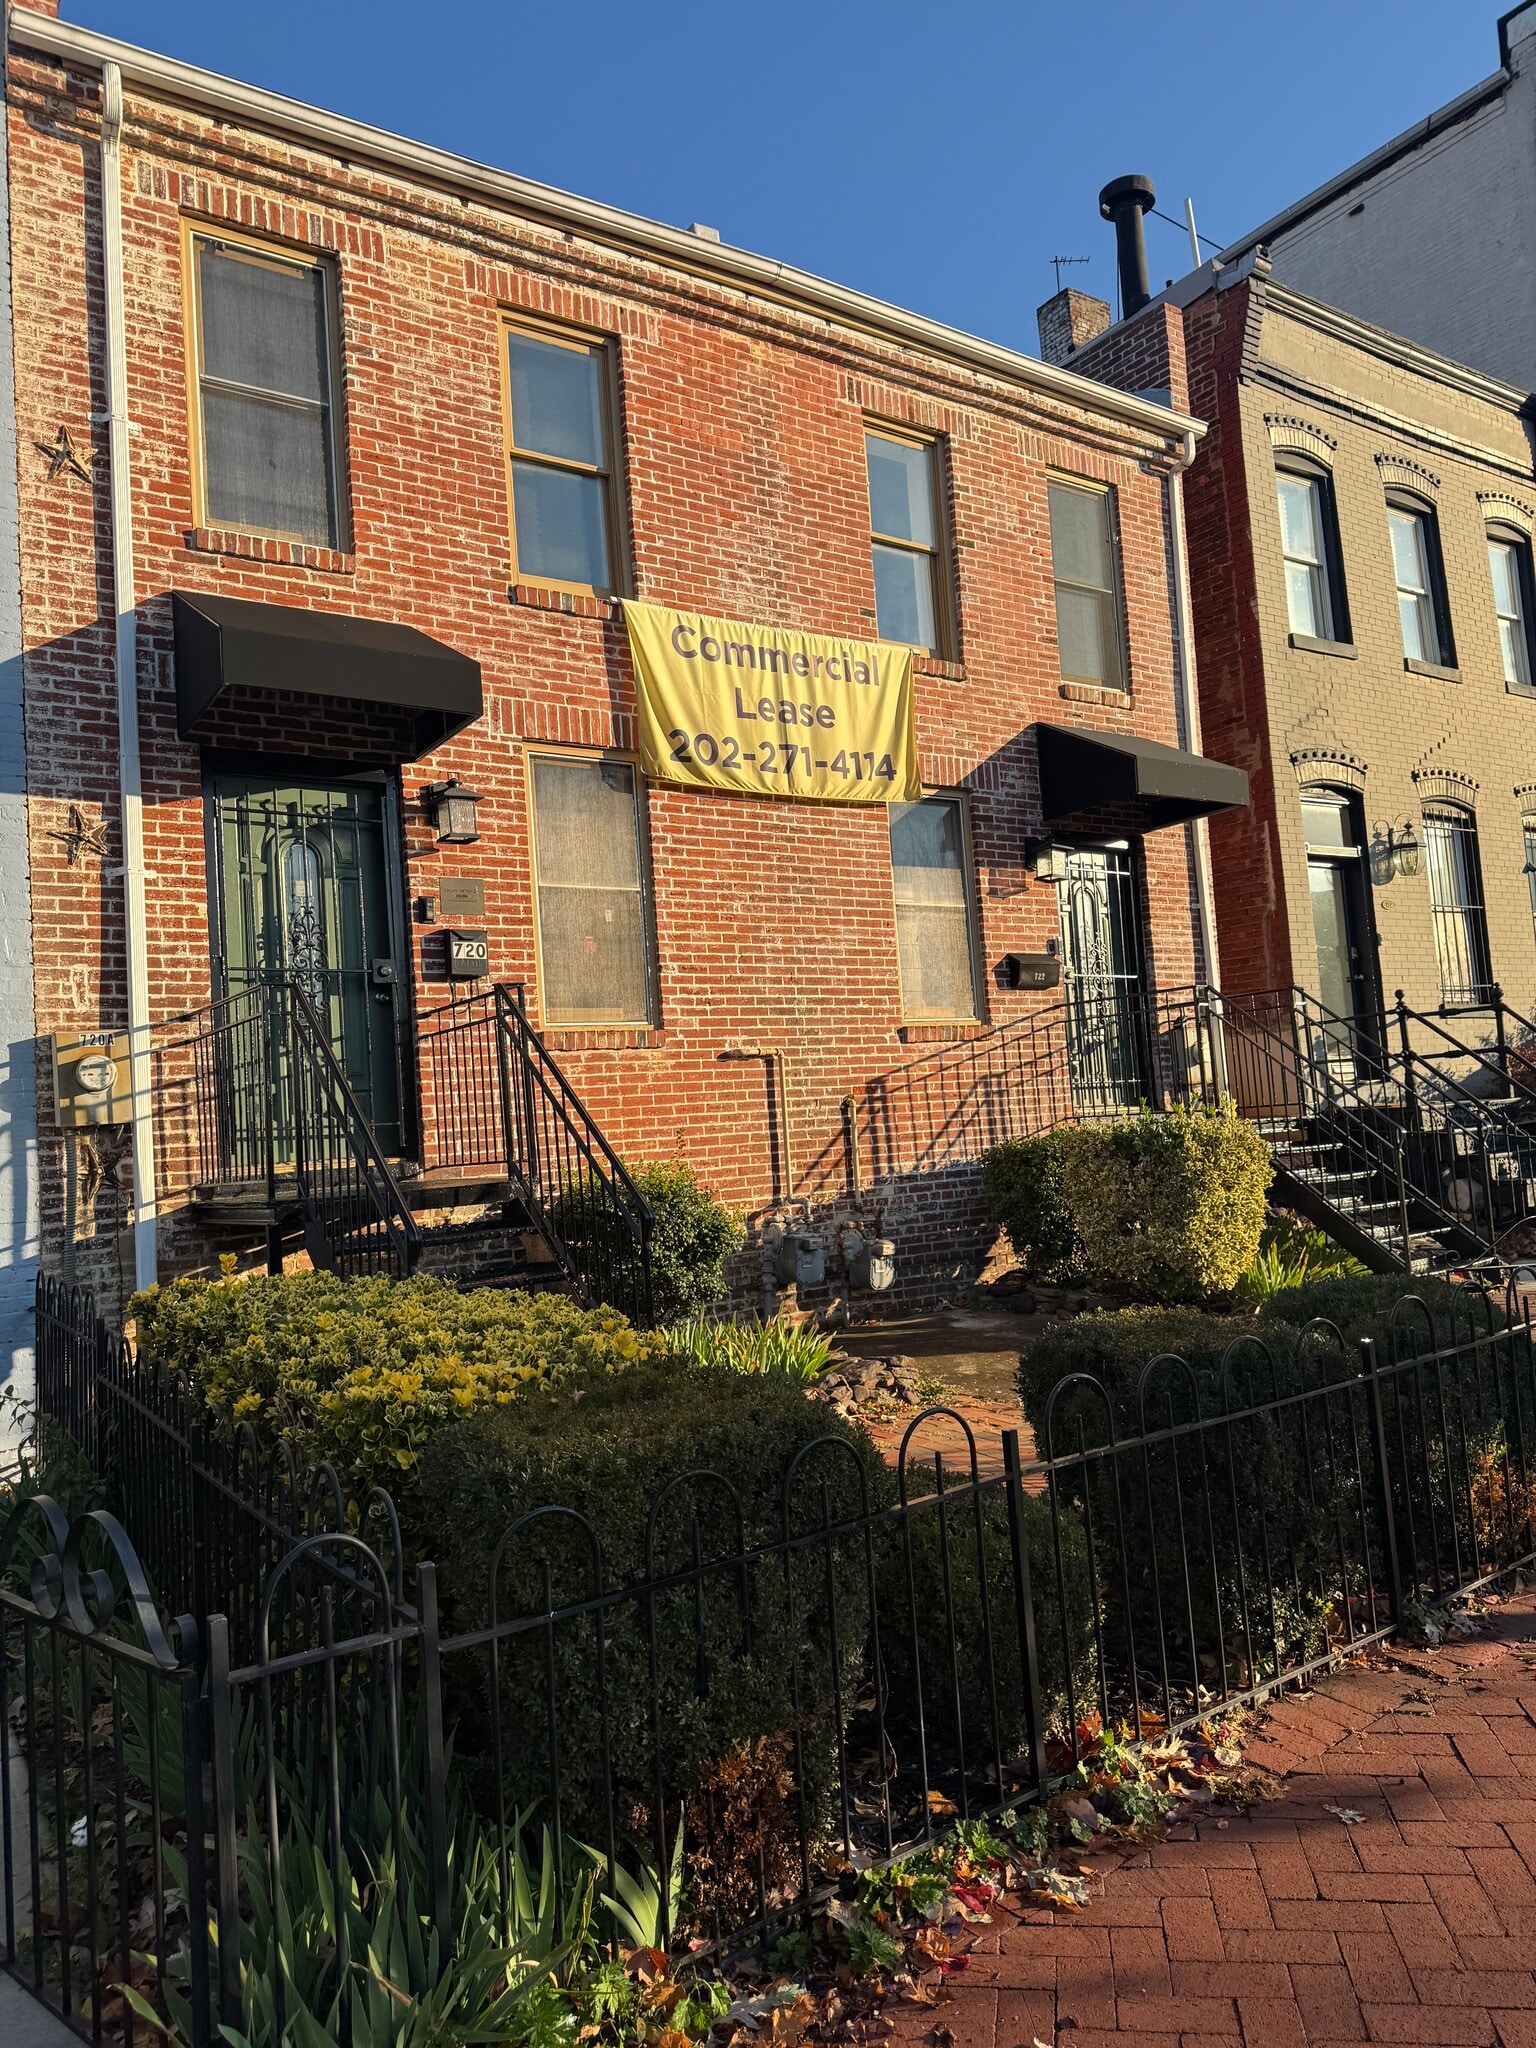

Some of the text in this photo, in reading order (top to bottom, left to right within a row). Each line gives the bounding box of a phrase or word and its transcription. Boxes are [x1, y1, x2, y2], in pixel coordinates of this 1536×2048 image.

[671, 624, 881, 686] Commercial
[735, 687, 836, 729] Lease
[668, 728, 897, 782] 202-271-4114
[454, 943, 485, 958] 720
[81, 1034, 114, 1046] 720A
